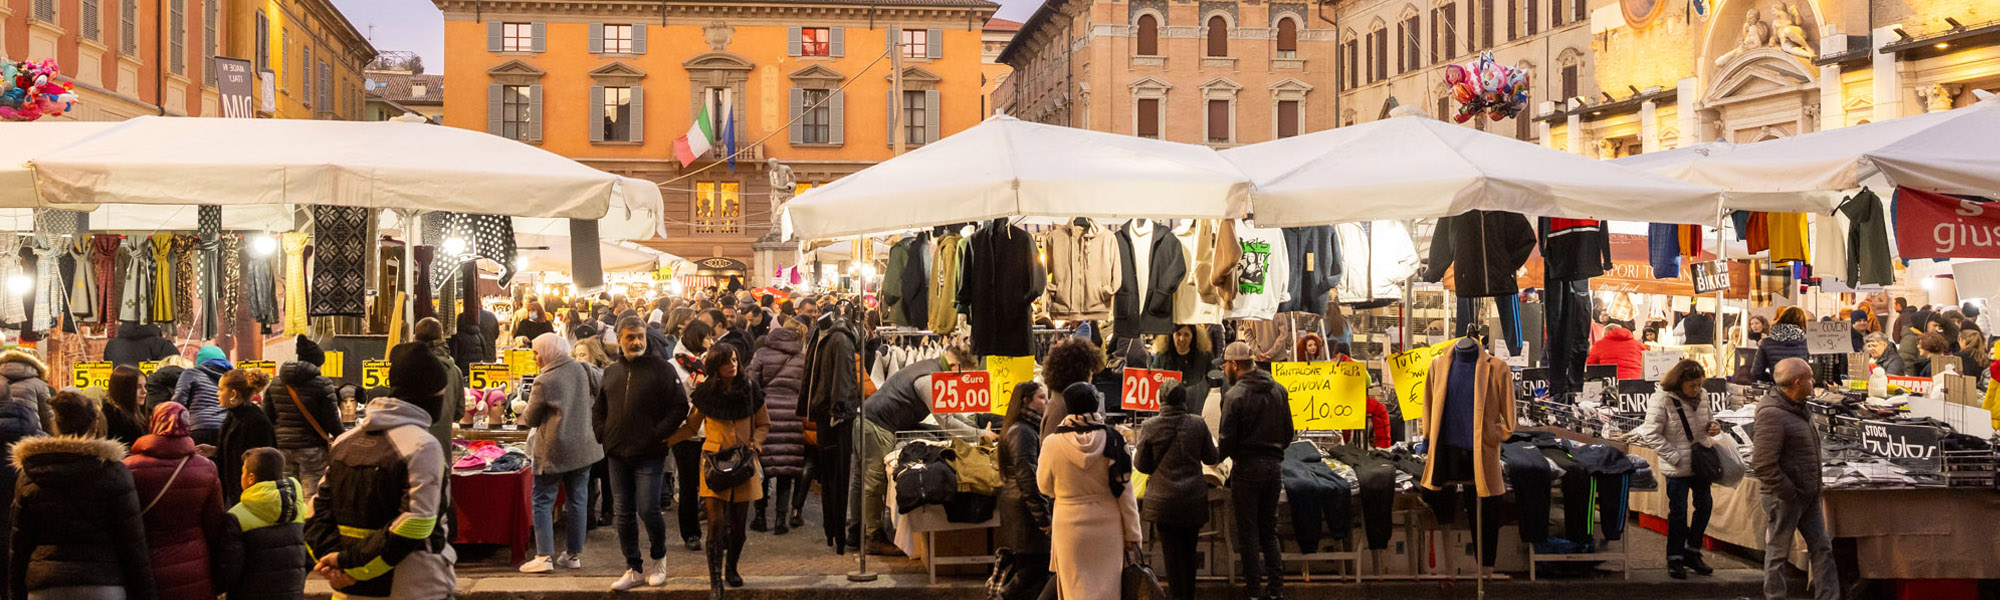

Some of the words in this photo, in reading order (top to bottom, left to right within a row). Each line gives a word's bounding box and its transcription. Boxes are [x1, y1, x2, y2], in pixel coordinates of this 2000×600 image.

[1393, 350, 1422, 369] TUTA
[1287, 379, 1331, 393] GIVOVA
[934, 379, 989, 411] 25,00
[1865, 425, 1888, 438] STOCK
